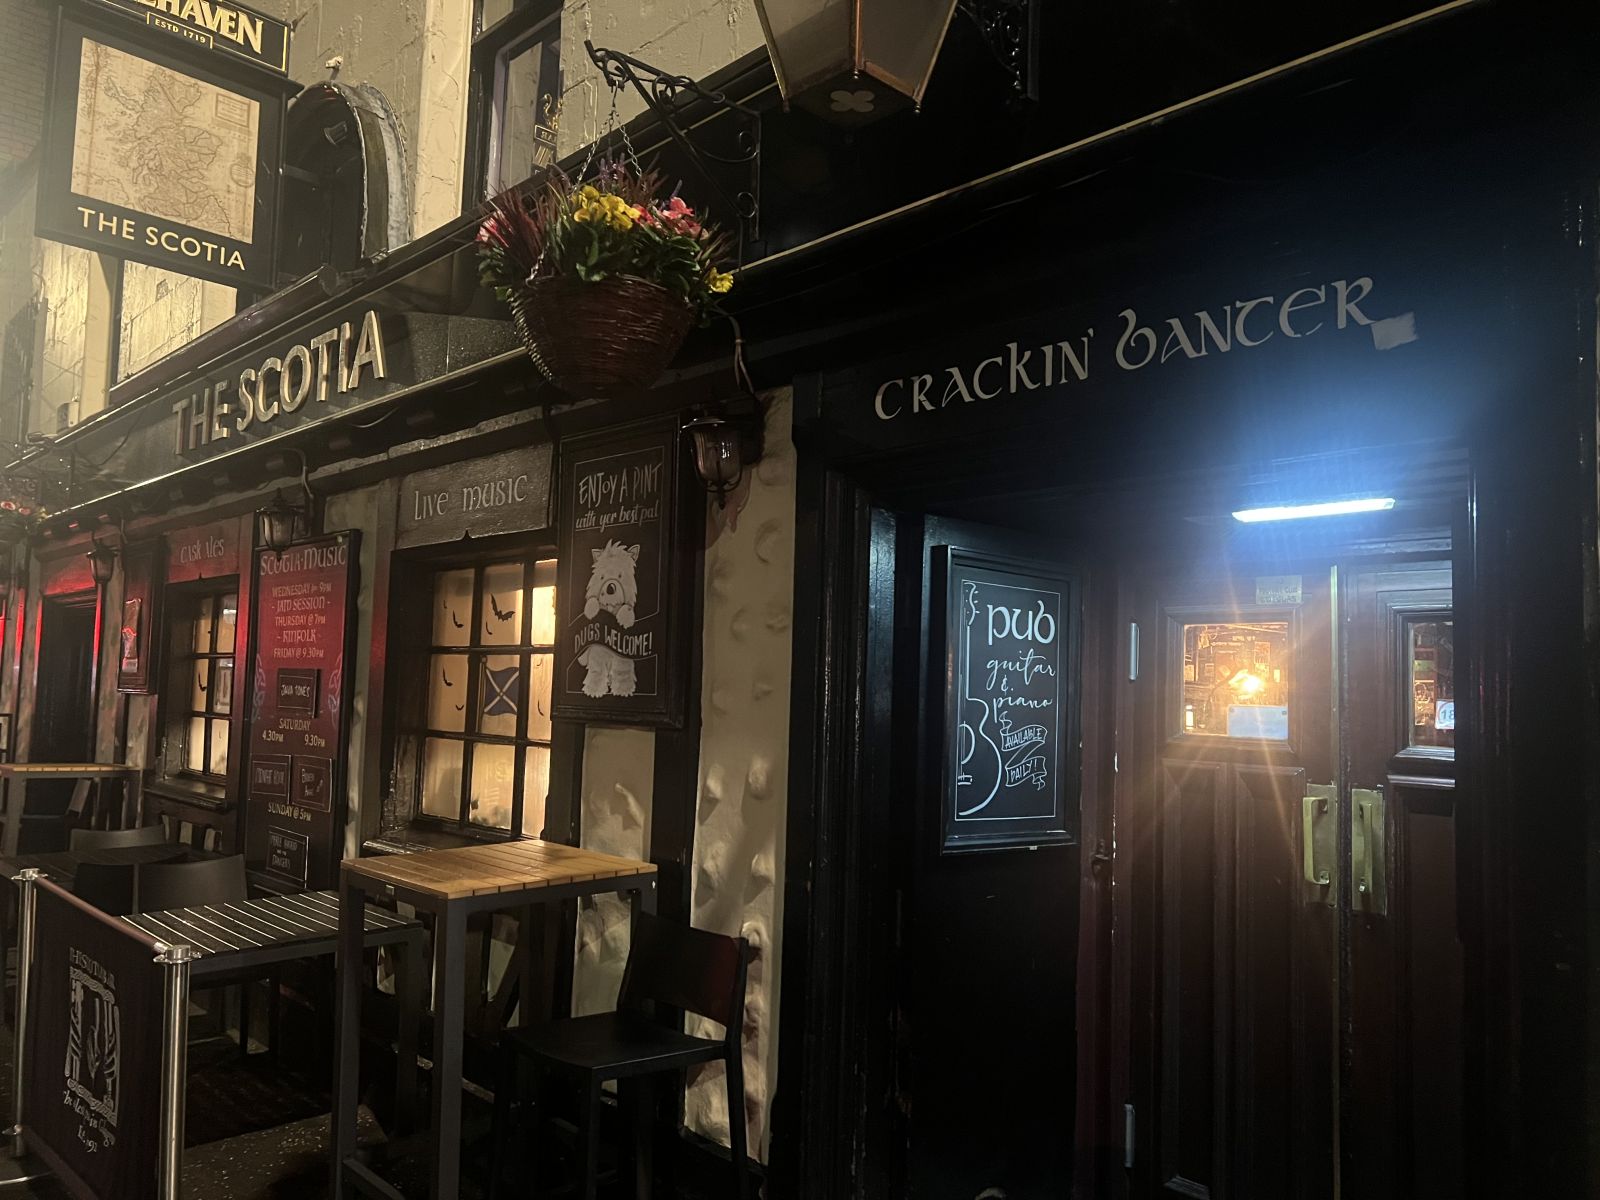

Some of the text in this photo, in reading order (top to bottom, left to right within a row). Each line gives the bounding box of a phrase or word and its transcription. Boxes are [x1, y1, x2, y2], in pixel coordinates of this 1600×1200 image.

[154, 18, 206, 44] ESTD 1719
[77, 206, 246, 271] THE SCOTIA
[172, 310, 386, 455] THE SCOTIA
[874, 327, 1094, 420] CRACKIN'
[620, 468, 628, 502] A
[633, 462, 662, 501] PINT
[575, 500, 659, 533] with yer best pal
[272, 583, 310, 598] WEDNESDAY
[275, 616, 307, 627] THURSDAY
[987, 600, 1056, 646] pub
[574, 622, 653, 655] DUGS WELCOME!
[273, 648, 294, 658] FRIDAY
[986, 648, 1056, 691] guitar
[993, 696, 1053, 724] piano
[262, 730, 284, 742] 4.30PM
[279, 717, 311, 731] SATURDAY
[304, 733, 326, 747] 9.30PM
[1005, 727, 1043, 749] AVAILABLE
[1010, 758, 1038, 783] DAILY!
[267, 800, 294, 817] SUNDAY
[300, 808, 312, 822] 5PM
